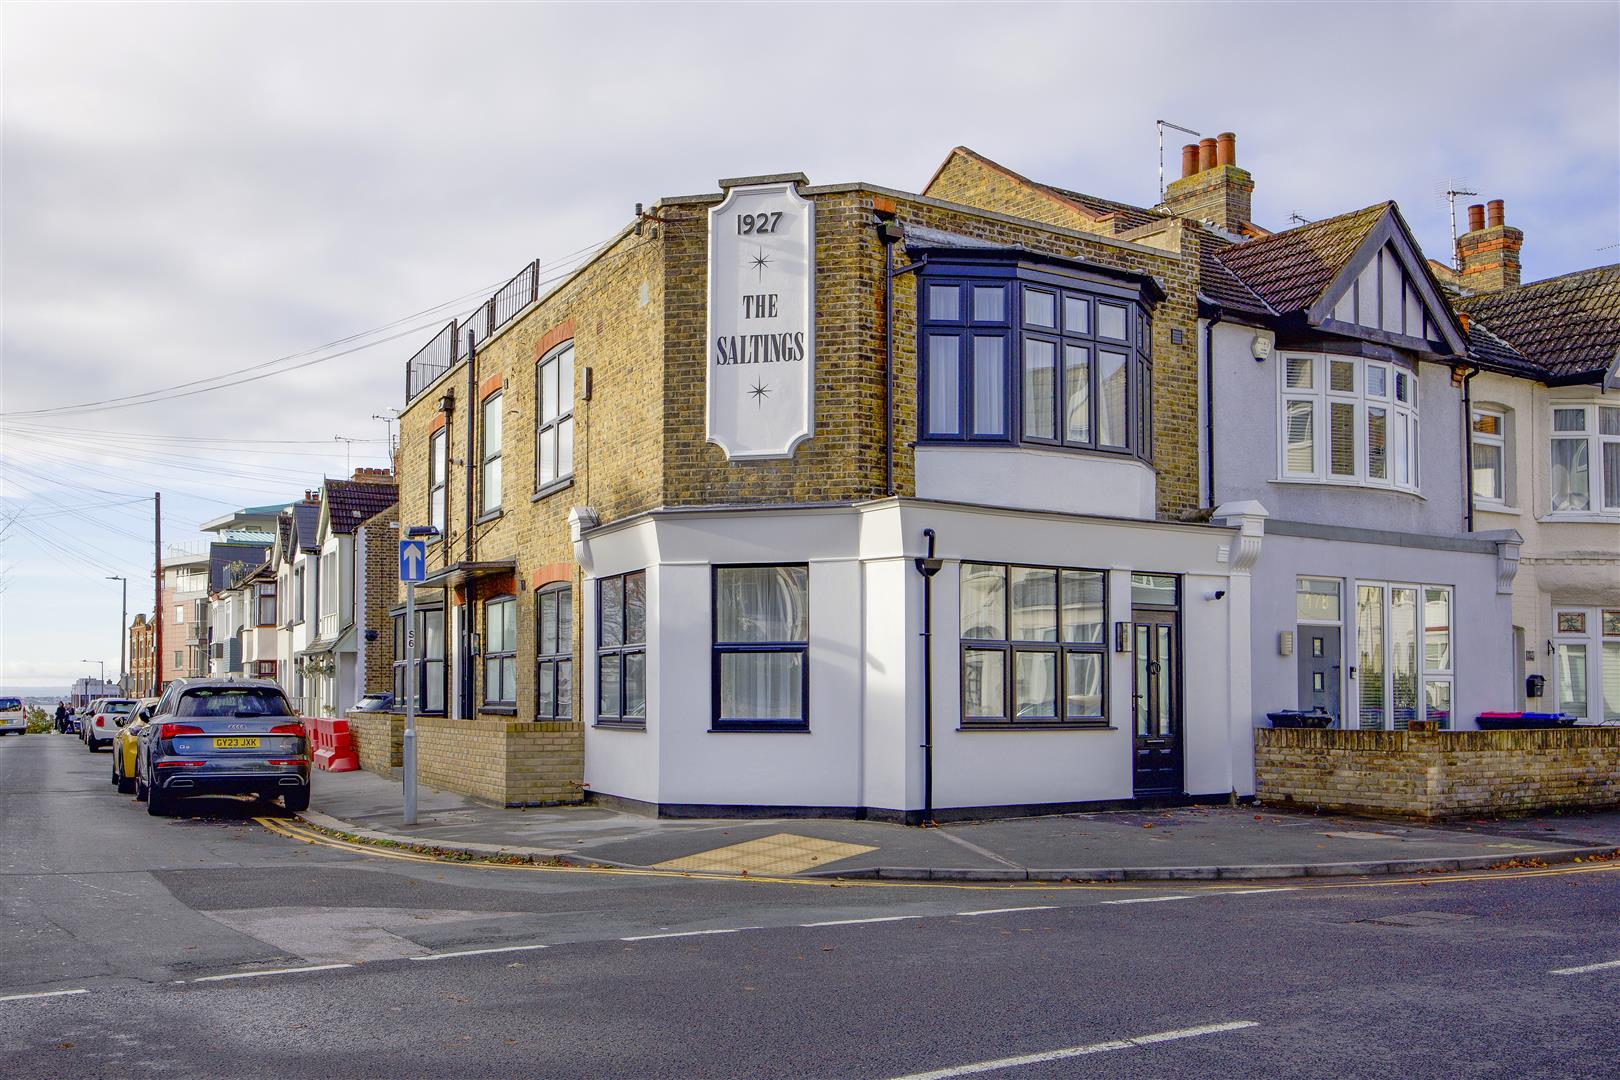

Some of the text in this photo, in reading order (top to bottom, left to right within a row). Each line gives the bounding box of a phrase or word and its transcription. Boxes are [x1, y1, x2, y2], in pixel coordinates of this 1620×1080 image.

[737, 211, 782, 235] 1927
[743, 294, 778, 319] THE
[716, 332, 804, 365] SALTINGS
[216, 738, 257, 747] GY23 JXK
